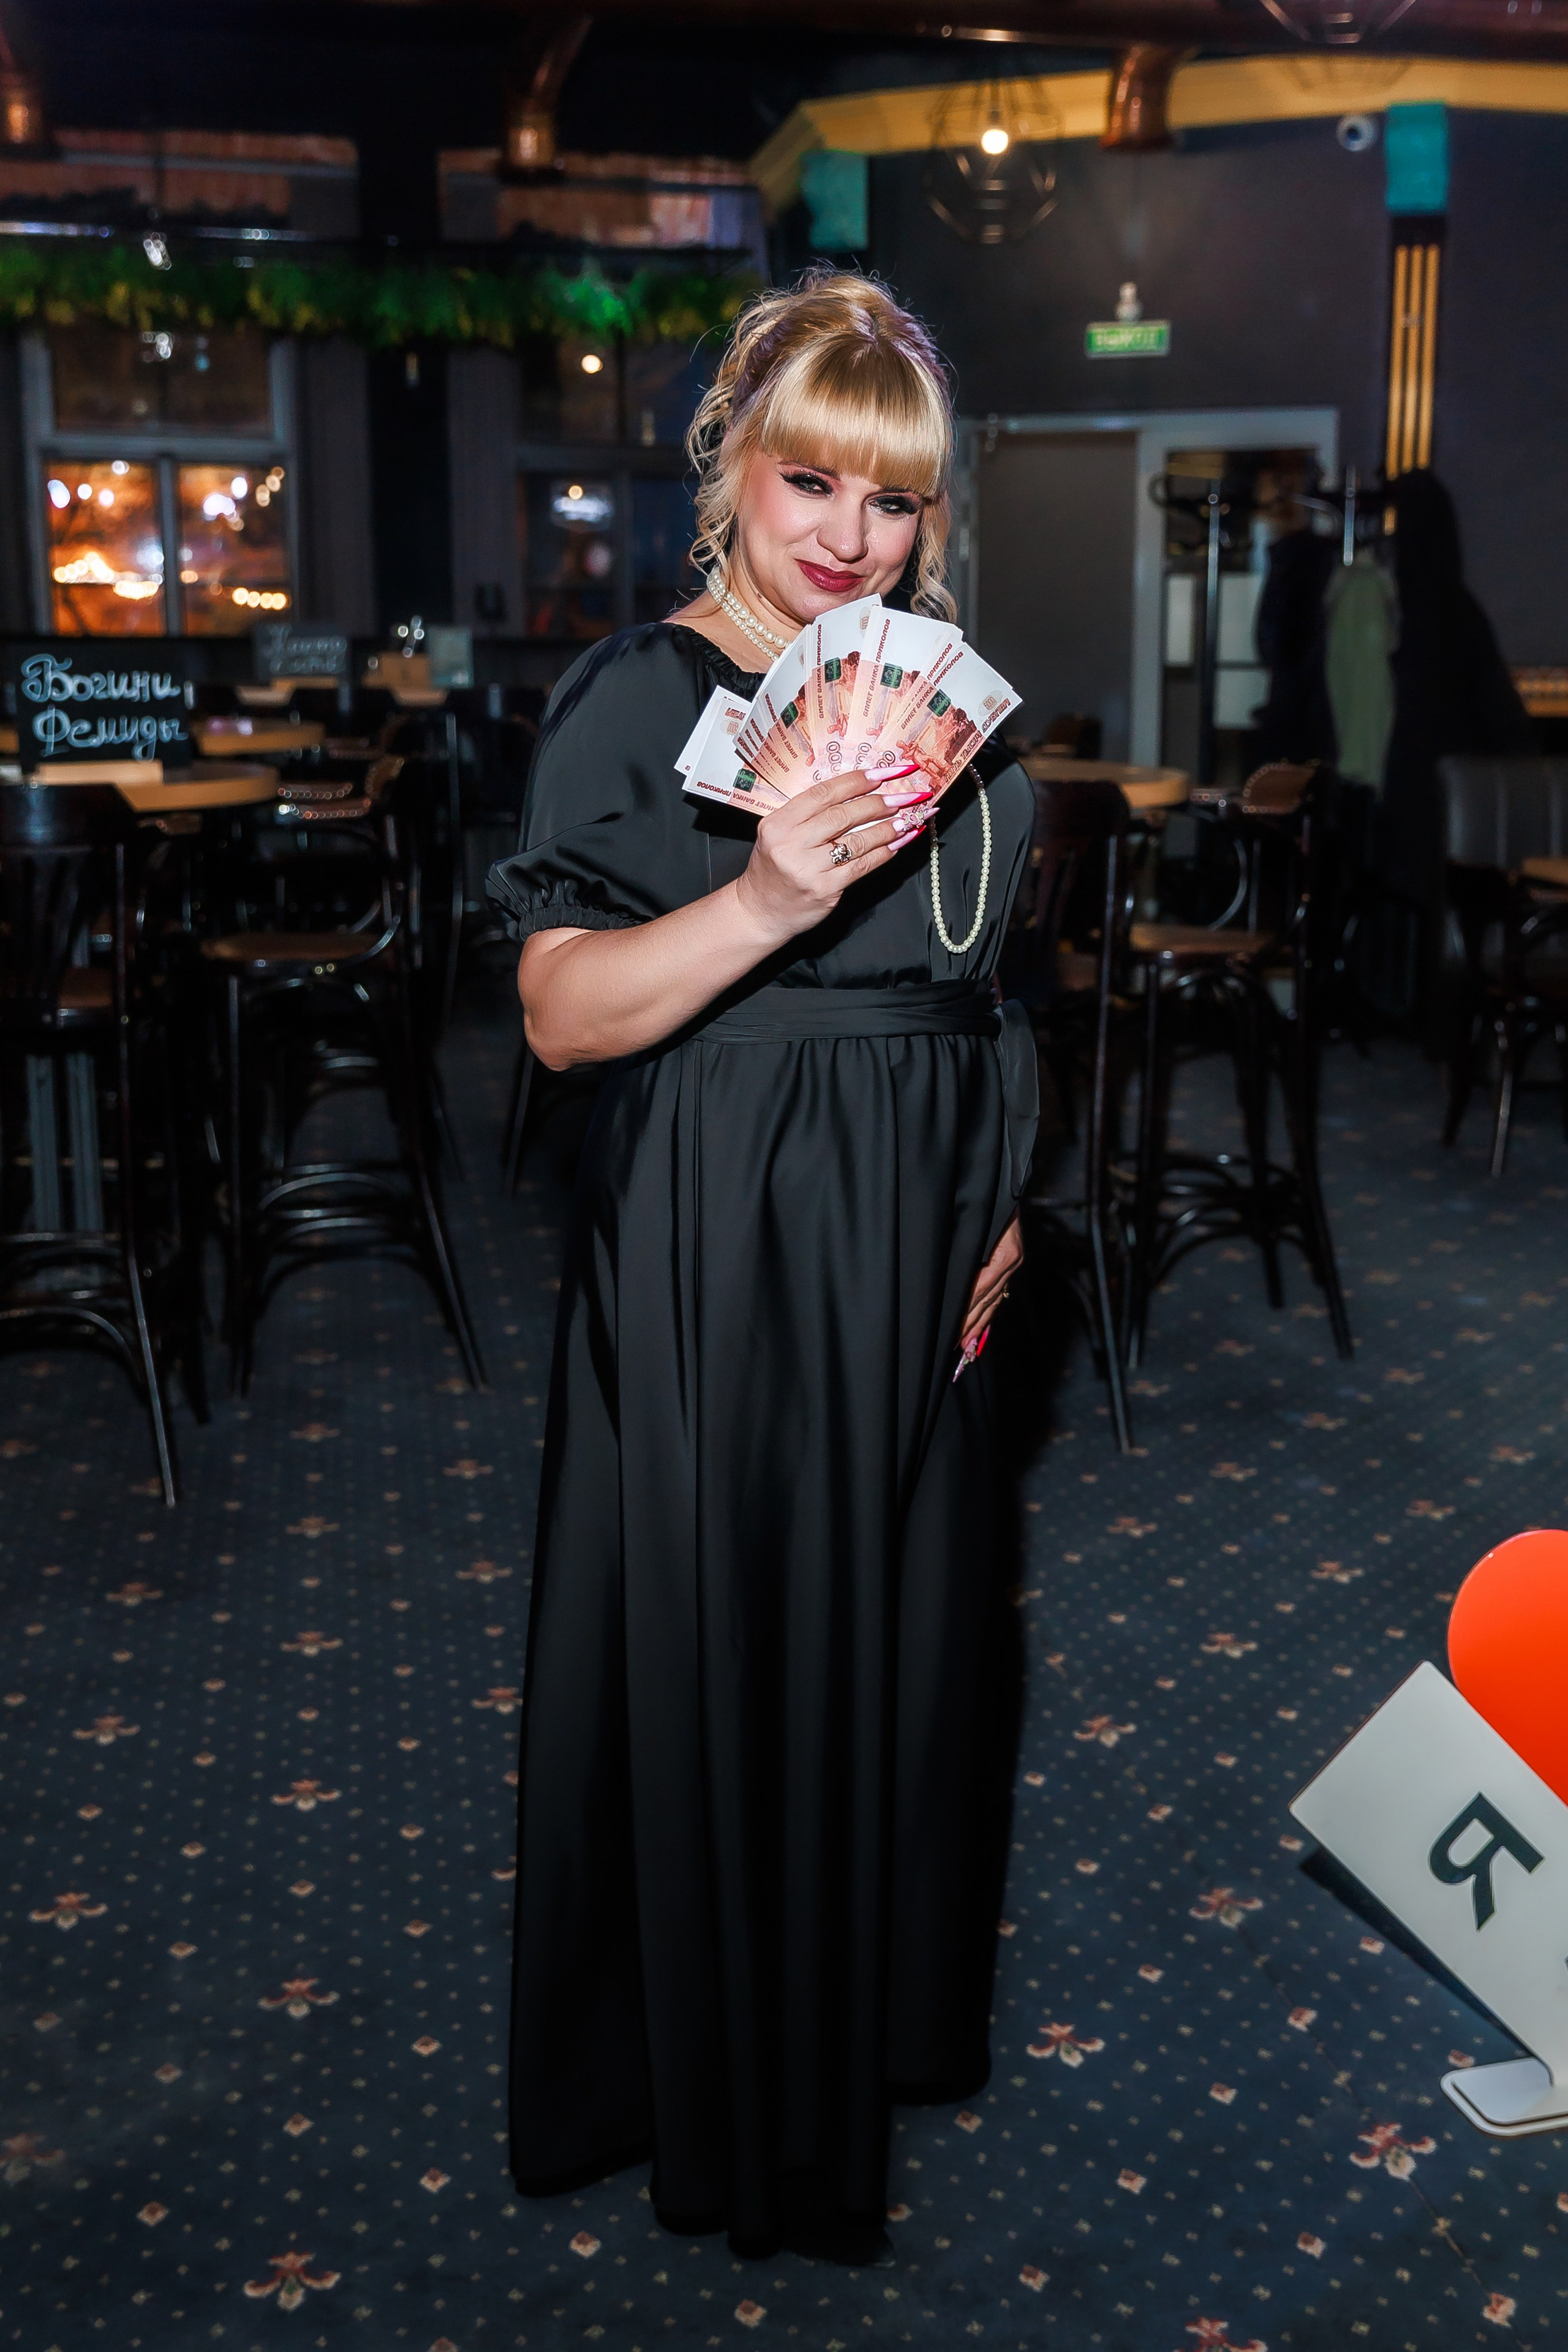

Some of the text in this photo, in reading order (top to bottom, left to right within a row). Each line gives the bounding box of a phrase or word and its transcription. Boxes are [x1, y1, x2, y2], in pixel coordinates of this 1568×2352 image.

[863, 693, 873, 717] БИЛЕТ
[869, 665, 879, 692] БАНКА
[876, 619, 891, 663] ПРИКОЛОВ
[927, 643, 953, 680] ПРИКОЛОВ
[21, 654, 181, 702] Богини
[901, 707, 918, 730] БИЛЕТ
[916, 687, 934, 709] БАНКА
[933, 651, 964, 687] ПРИКОЛОВ
[983, 696, 997, 709] 5000
[32, 704, 189, 763] Фемиды
[776, 722, 787, 742] БАНКА
[763, 741, 777, 758] БАНКА
[785, 741, 798, 760] БИЛЕТ
[960, 730, 982, 760] ТЫСЯЧ
[774, 756, 790, 772] БИЛЕТ
[827, 741, 842, 775] 000
[697, 782, 732, 796] ПРИКОЛОВ
[733, 793, 754, 805] БАНКА
